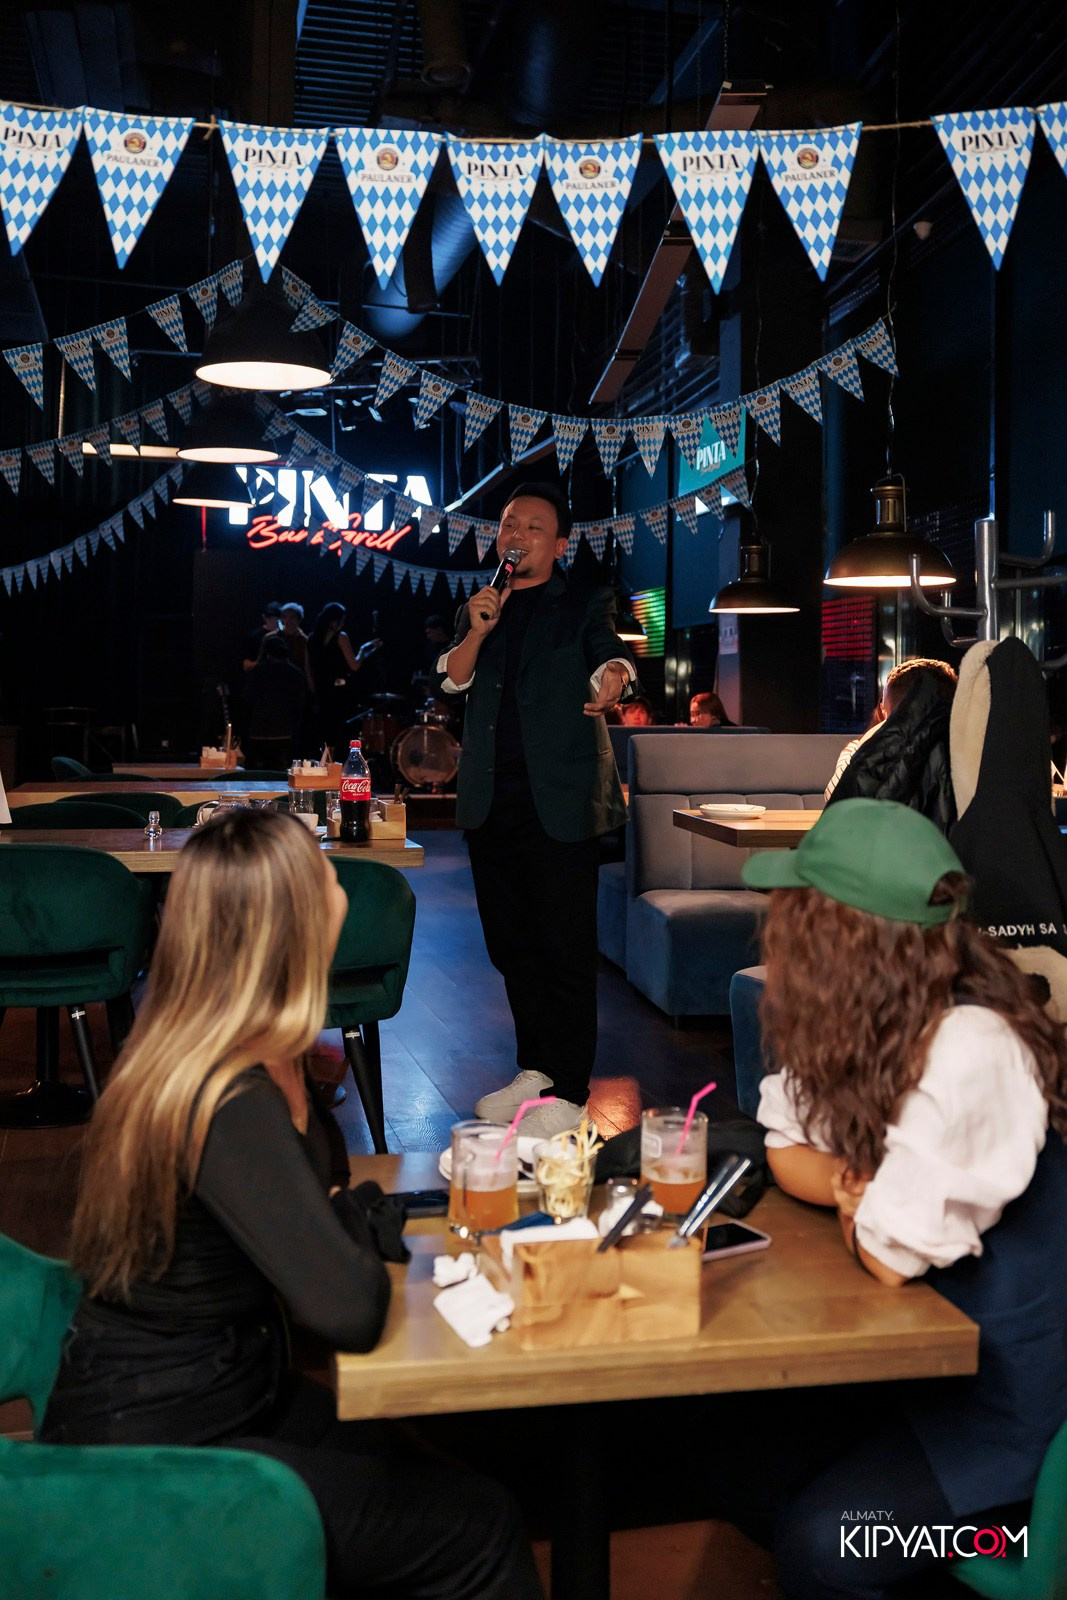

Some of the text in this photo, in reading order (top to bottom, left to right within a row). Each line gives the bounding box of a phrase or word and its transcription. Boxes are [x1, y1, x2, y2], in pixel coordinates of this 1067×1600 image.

[3, 127, 61, 149] PINTA
[961, 130, 1020, 153] PINTA
[105, 153, 160, 168] PAULANER
[244, 146, 302, 166] PINTA
[682, 152, 741, 172] PINTA
[467, 161, 524, 177] PINTA
[784, 169, 836, 182] PAULANER
[361, 173, 413, 184] PAULANER
[565, 179, 617, 190] PAULANER
[860, 332, 884, 350] PINTA
[789, 376, 814, 391] PINTA
[713, 409, 738, 421] PINTA
[558, 422, 582, 433] PINTA
[696, 438, 726, 471] PINTA
